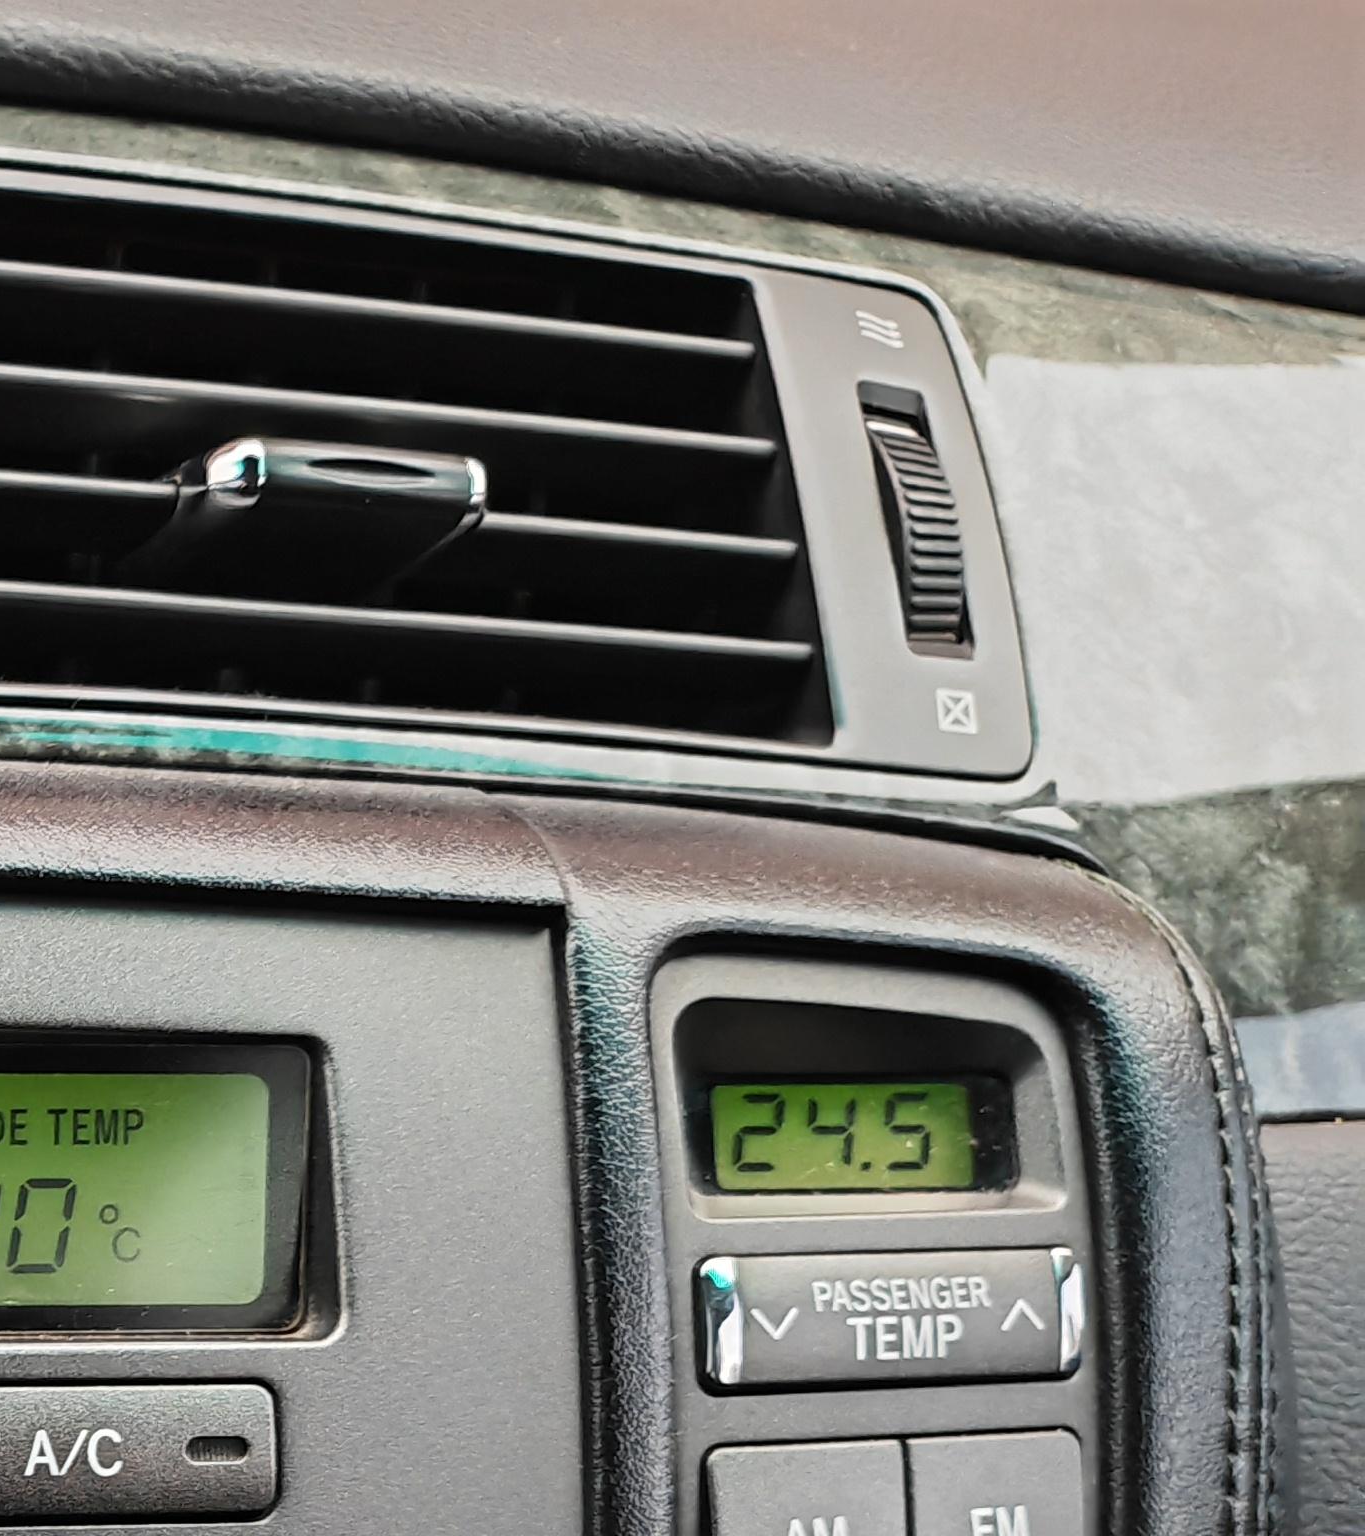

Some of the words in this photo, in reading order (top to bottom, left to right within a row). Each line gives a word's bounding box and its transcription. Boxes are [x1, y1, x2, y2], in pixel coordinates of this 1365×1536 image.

[47, 1106, 146, 1147] TEMP
[732, 1092, 932, 1173] 24.5
[810, 1275, 993, 1314] PASSENGER
[845, 1314, 966, 1362] TEMP
[23, 1427, 126, 1480] A/C
